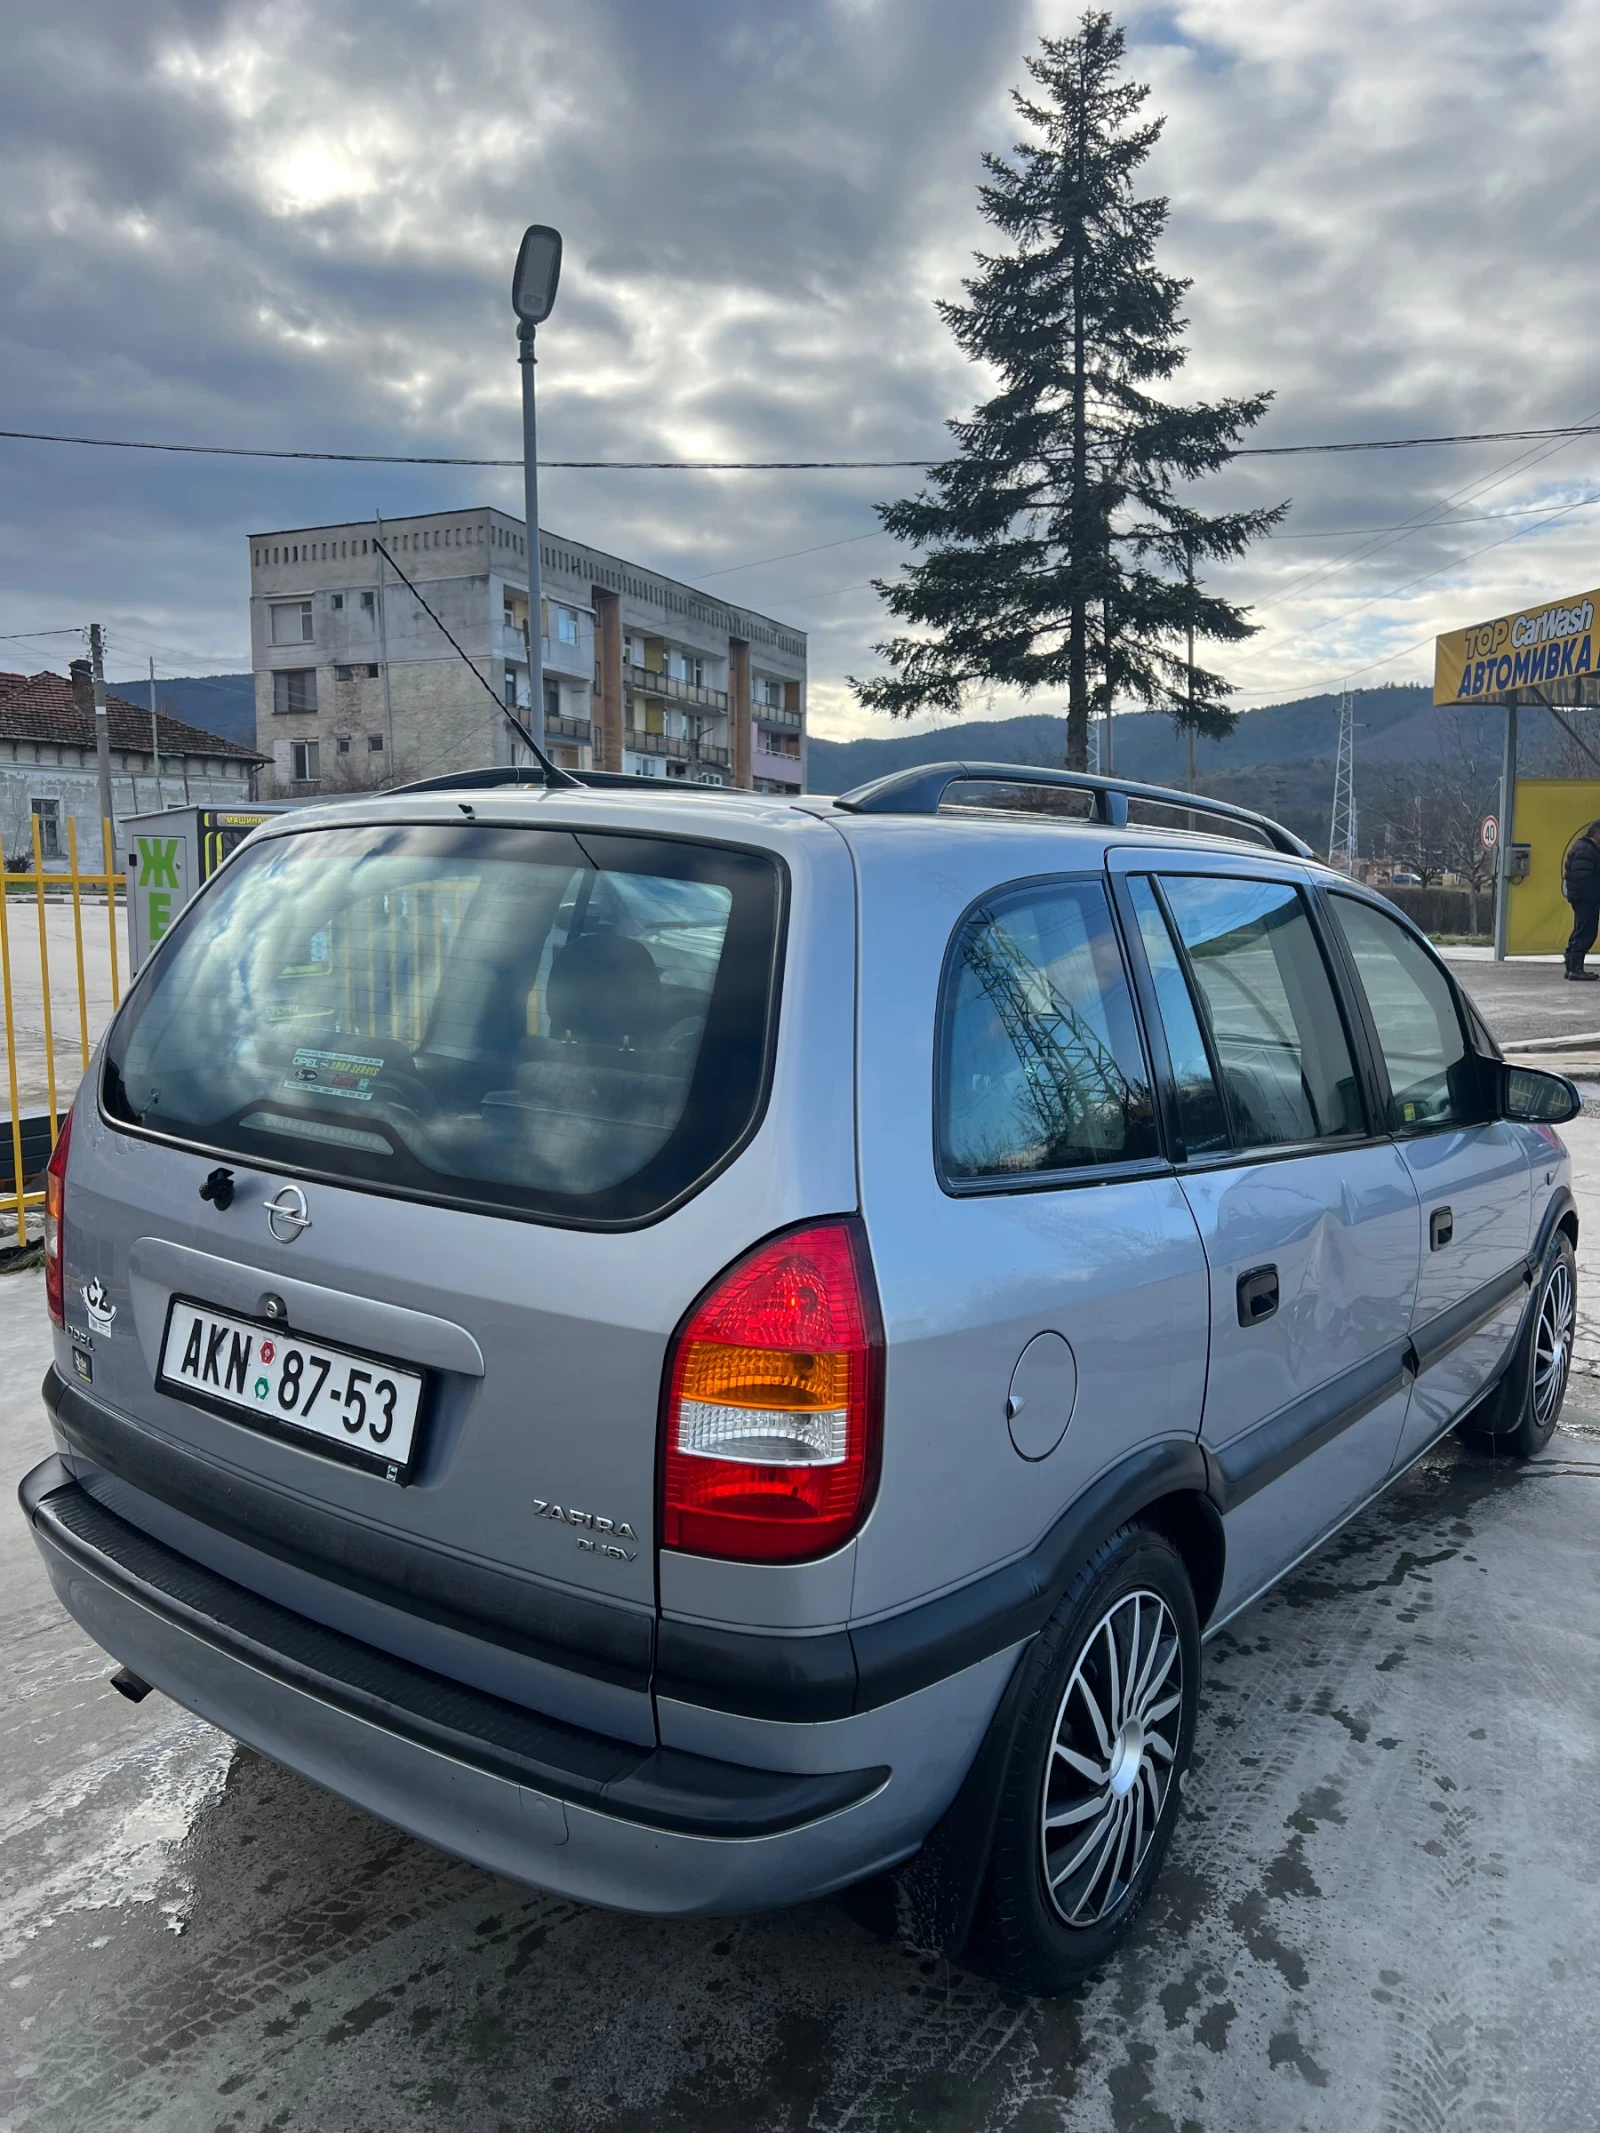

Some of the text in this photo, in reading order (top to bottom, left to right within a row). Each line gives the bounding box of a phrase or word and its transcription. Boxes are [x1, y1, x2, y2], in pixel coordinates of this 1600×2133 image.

[1465, 598, 1594, 660] TOP CarWash
[1457, 635, 1591, 698] АВТОМИВКА
[226, 816, 262, 825] МАШИНА
[1485, 825, 1495, 841] 40
[292, 1057, 318, 1068] OPEL
[350, 1064, 380, 1076] SERVIS
[67, 1325, 96, 1352] OPEL
[181, 1318, 398, 1443] AKN 87-53
[533, 1499, 638, 1542] ZAFIRA
